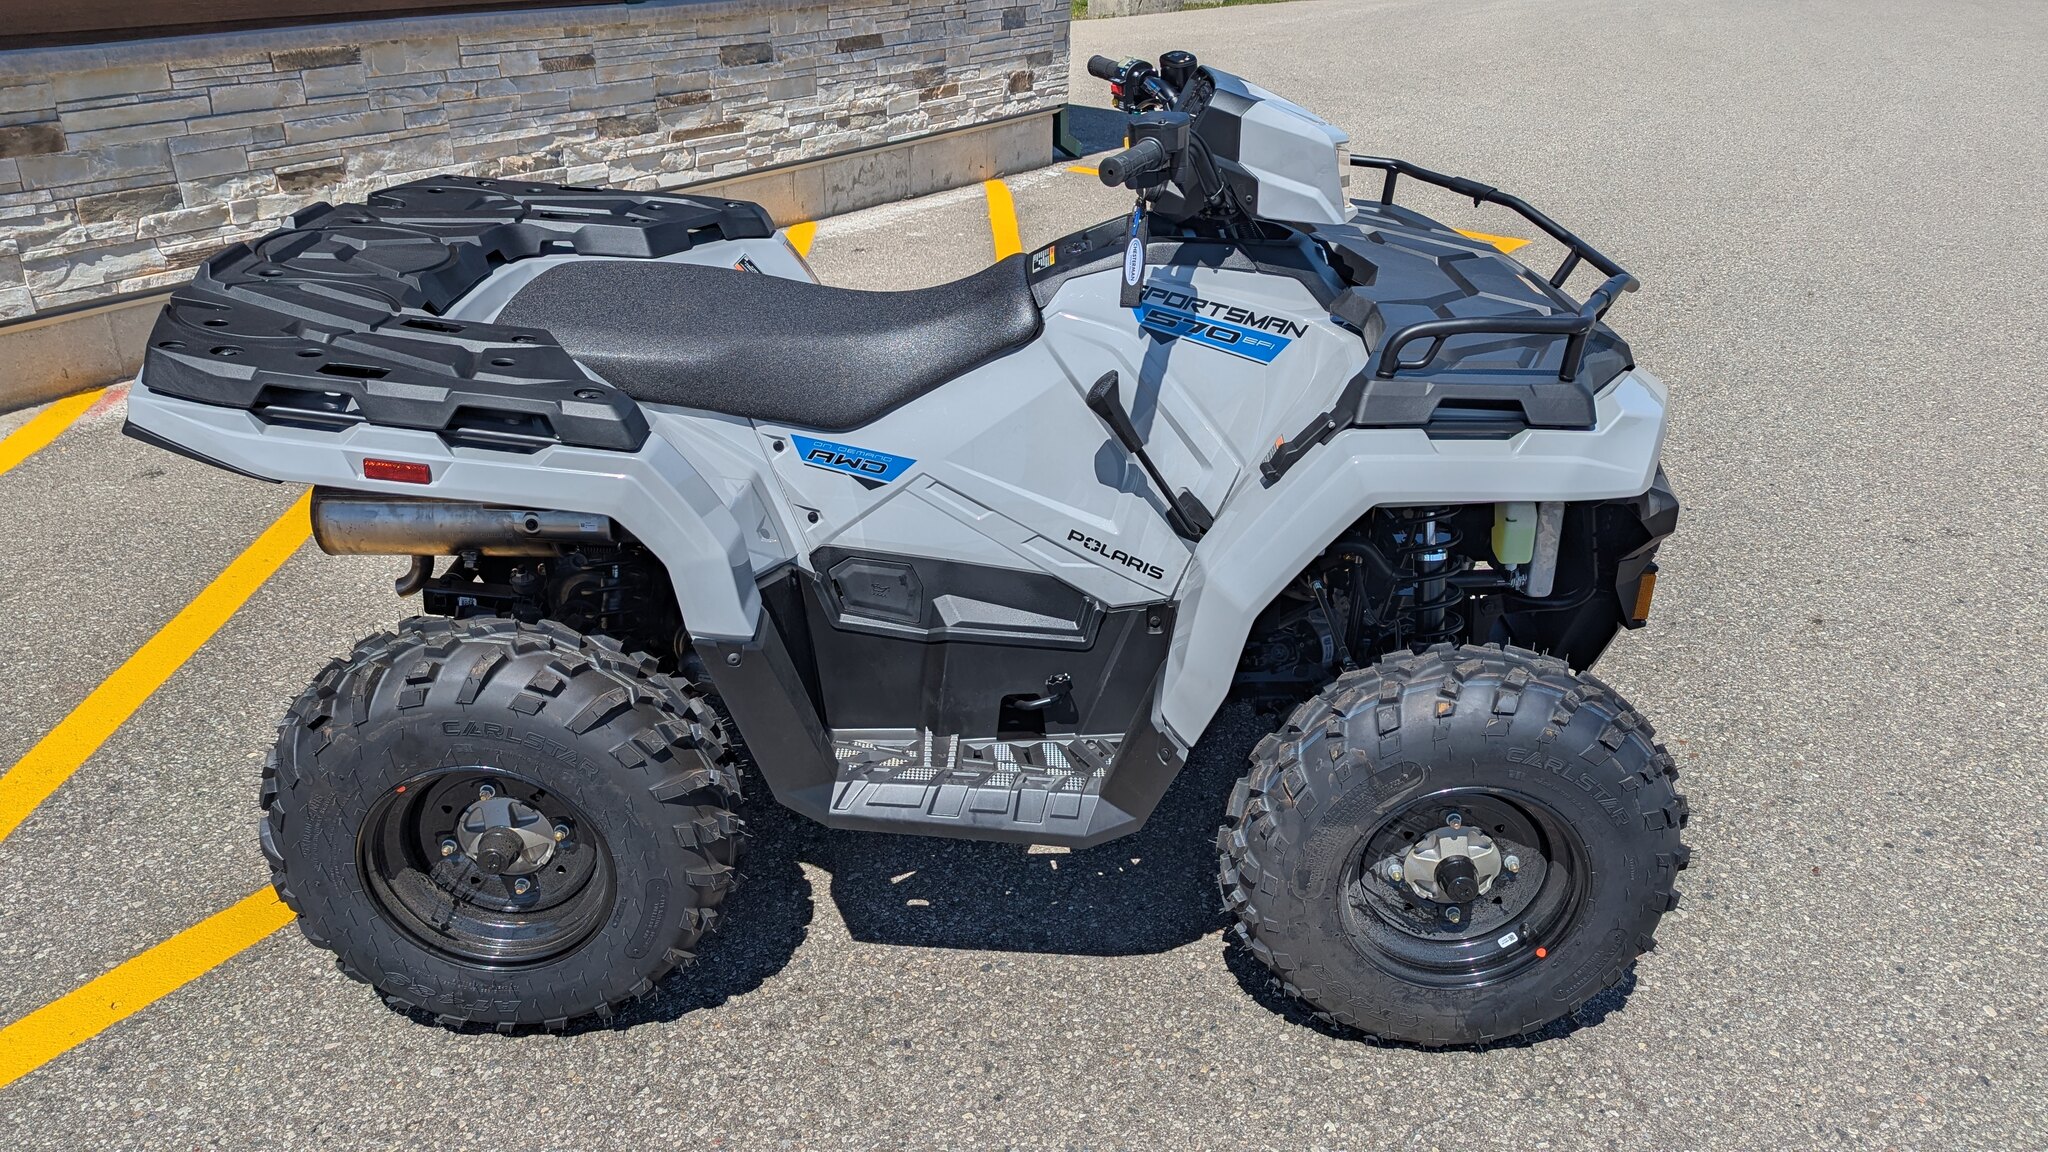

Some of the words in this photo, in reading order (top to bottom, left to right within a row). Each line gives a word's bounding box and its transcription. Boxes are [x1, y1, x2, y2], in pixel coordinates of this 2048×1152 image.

[1130, 242, 1138, 282] CHESTERMAN
[1144, 309, 1242, 345] 570
[1243, 336, 1275, 350] EFI
[807, 449, 889, 474] AWD
[813, 441, 833, 449] ON
[837, 446, 893, 463] DEMAND
[1067, 529, 1165, 580] POLARIS
[441, 719, 600, 779] CARLSTAR
[1505, 746, 1631, 828] CARLSTAR
